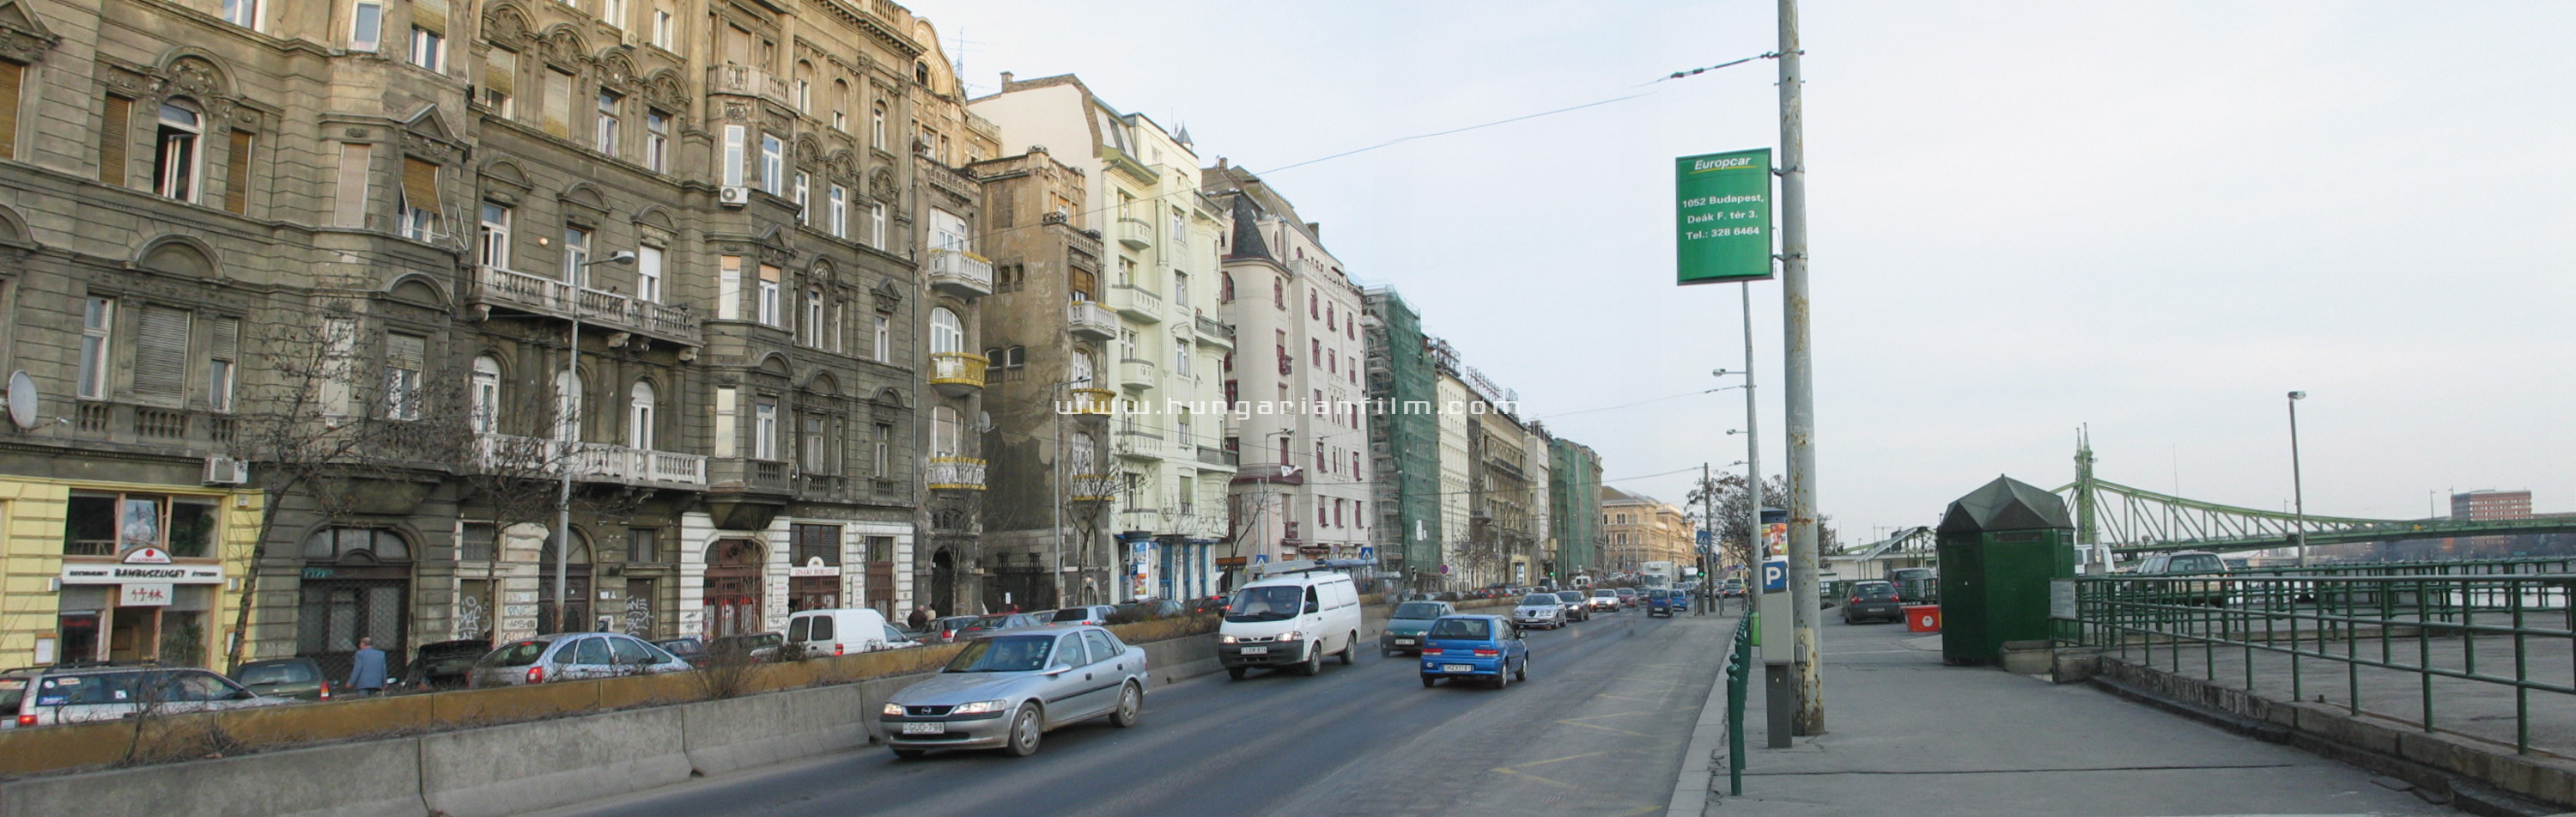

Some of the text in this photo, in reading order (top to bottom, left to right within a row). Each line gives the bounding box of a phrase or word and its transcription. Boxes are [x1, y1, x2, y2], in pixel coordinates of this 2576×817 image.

[1694, 157, 1752, 170] Europcar
[1683, 194, 1765, 208] 1052 Budapest,
[1687, 210, 1759, 224] Deák F. tér 3.
[1686, 226, 1760, 240] Tel.: 328 6464
[114, 569, 185, 577] BAMBUSZLIGET
[1765, 566, 1782, 585] P
